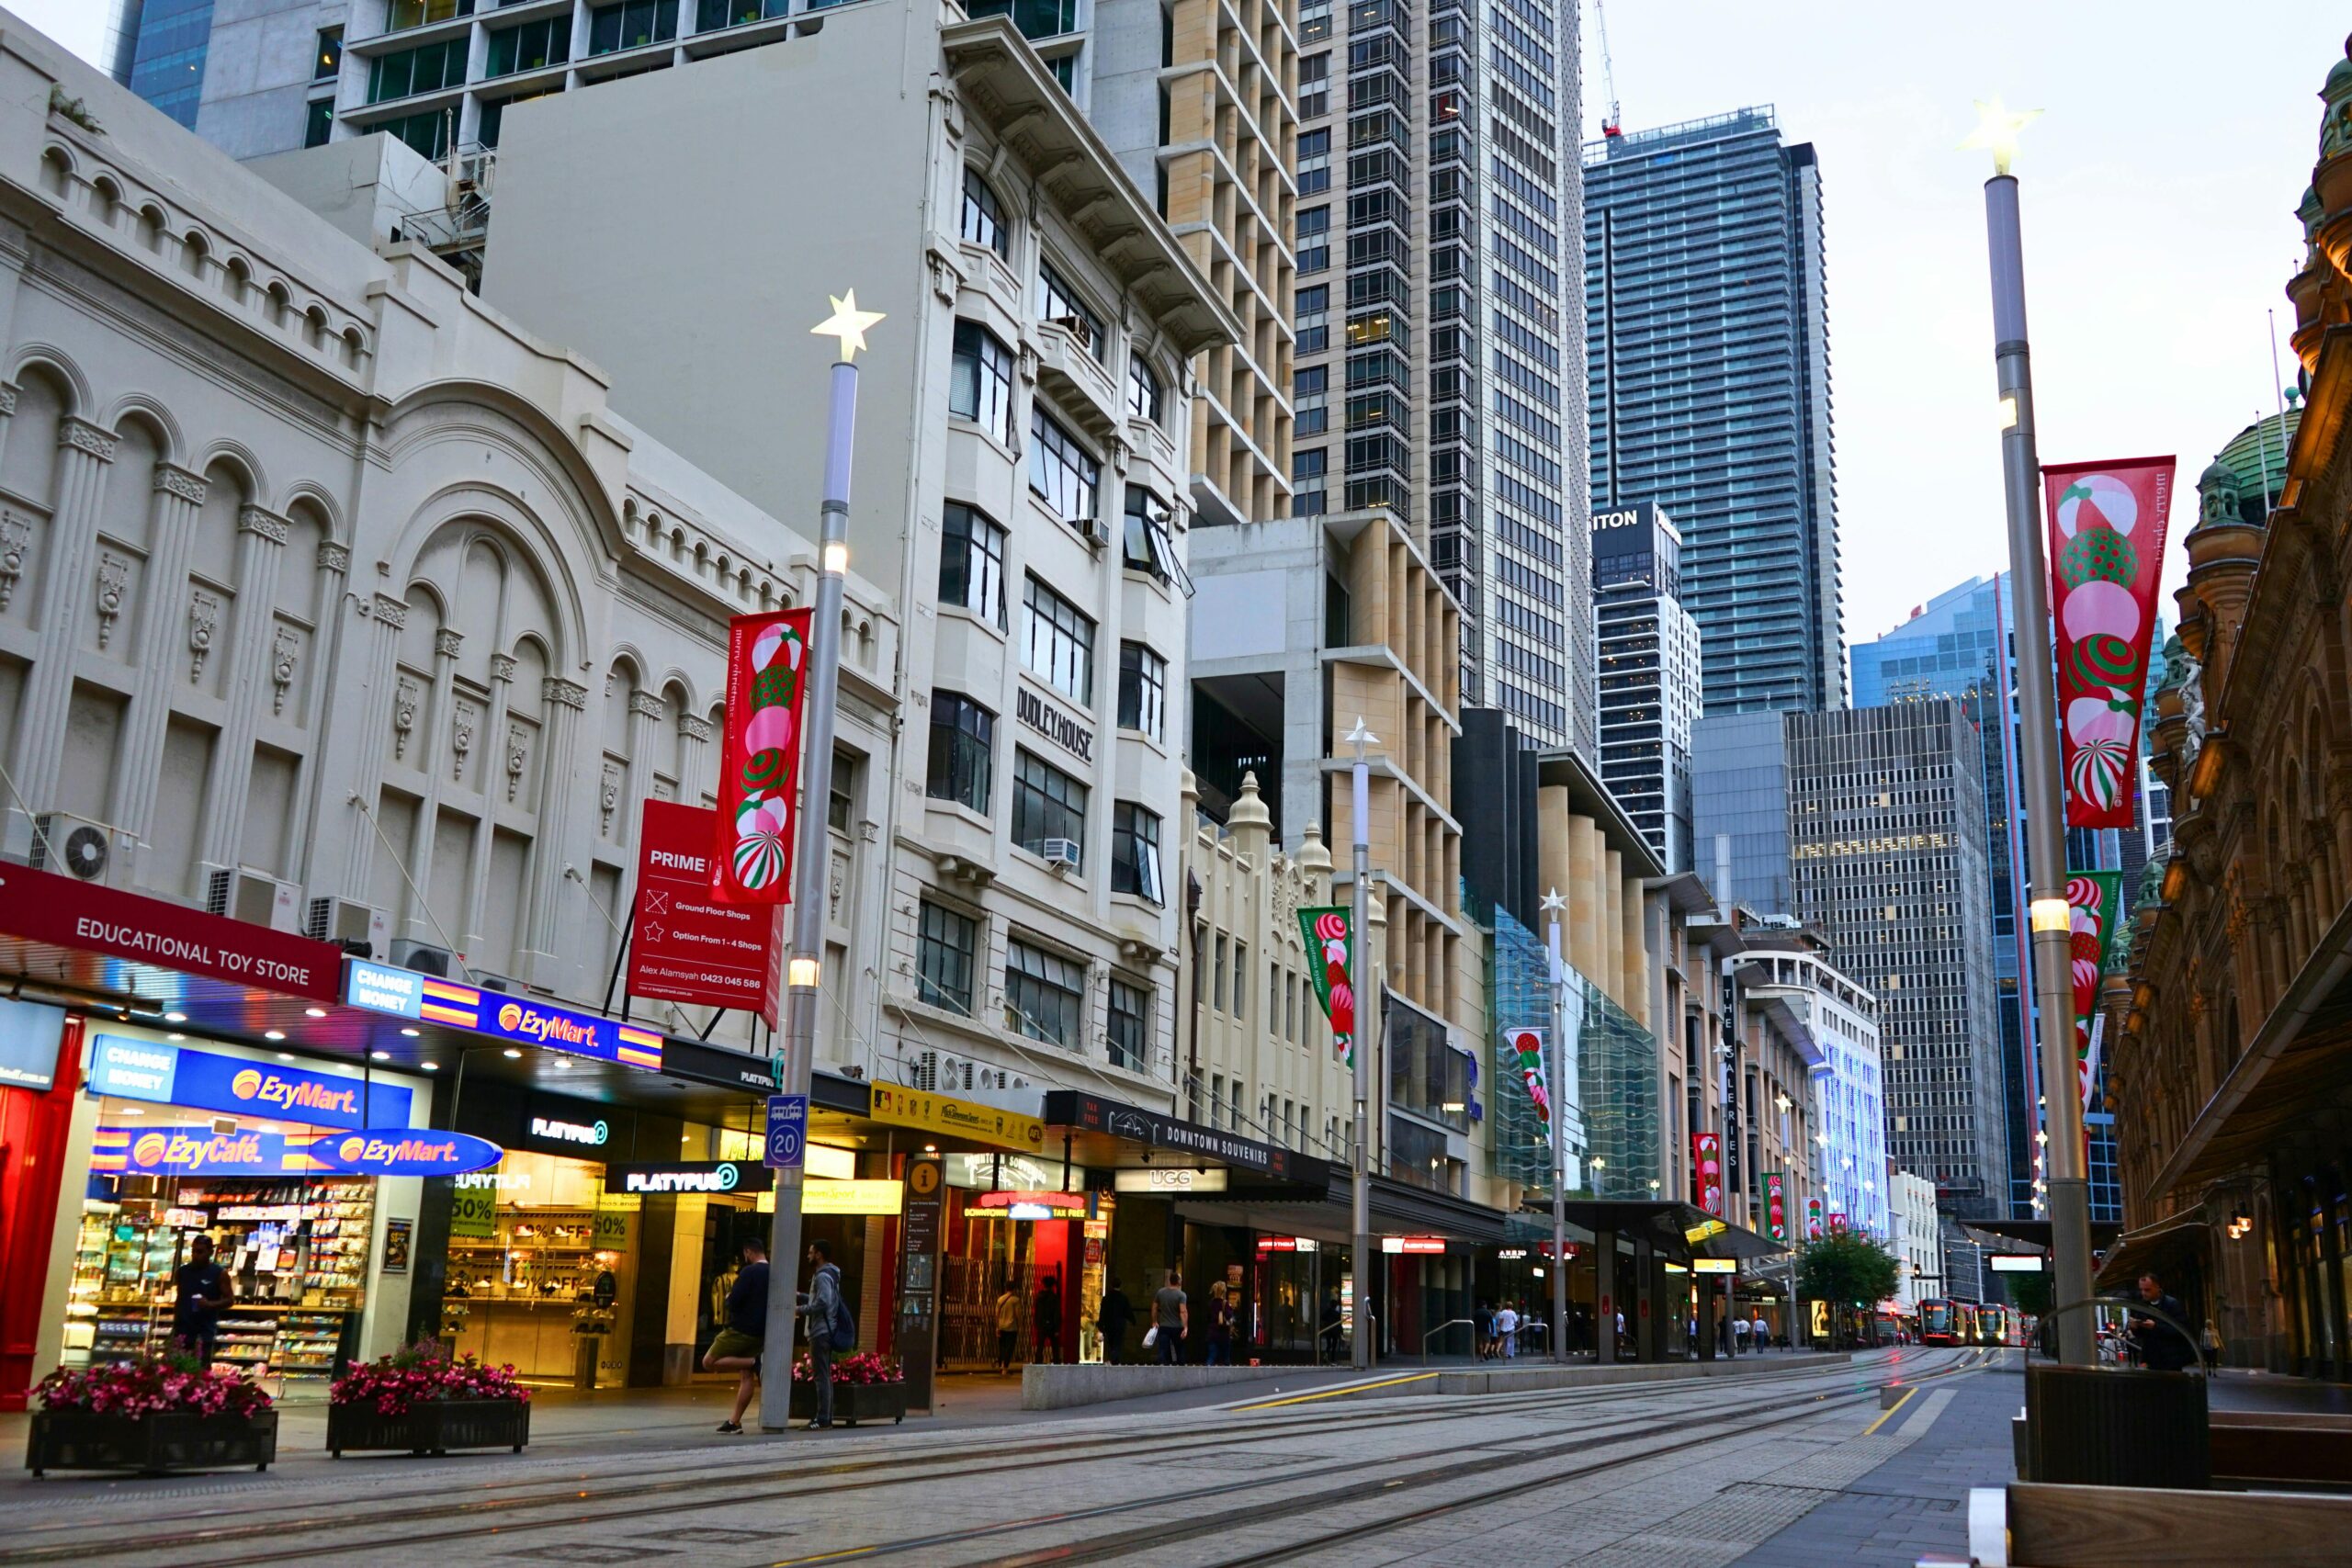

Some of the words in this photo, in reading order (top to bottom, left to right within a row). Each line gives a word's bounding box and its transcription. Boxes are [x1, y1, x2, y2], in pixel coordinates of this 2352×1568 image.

[733, 629, 742, 661] merry
[650, 850, 706, 873] PRIME
[675, 901, 705, 914] Ground
[706, 906, 725, 917] Floor
[727, 909, 751, 920] Shops
[76, 917, 213, 964] EDUCATIONAL
[219, 950, 253, 973] TOY
[255, 958, 310, 986] STORE
[673, 931, 699, 942] Option
[700, 935, 720, 944] From
[738, 941, 762, 951] Shops
[356, 969, 413, 995] CHANGE
[639, 965, 658, 976] Alex
[660, 967, 699, 981] Alamsyah
[700, 973, 723, 984] 0423
[725, 976, 741, 987] 045
[743, 979, 761, 989] 586
[359, 987, 408, 1011] MONEY
[1724, 988, 1733, 1028] THE
[519, 1010, 598, 1048] EzyMart
[107, 1046, 172, 1072] CHANGE
[107, 1068, 164, 1090] MONEY
[741, 1071, 775, 1089] PLATYPUS
[257, 1076, 357, 1113] EzyMart
[1724, 1045, 1737, 1167] GALERIES
[531, 1118, 597, 1144] PLATYPUS
[163, 1134, 263, 1169] EzyCafé
[363, 1139, 458, 1167] EzyMart
[774, 1134, 795, 1154] 20
[1167, 1126, 1218, 1152] DOWNTOWN
[1222, 1141, 1268, 1165] SOUVENIRS
[964, 1152, 1005, 1168] DOWNTON
[628, 1173, 723, 1191] PLATYPUS
[1150, 1170, 1192, 1186] UGG
[1053, 1208, 1066, 1217] TAX
[1068, 1208, 1085, 1217] FREE
